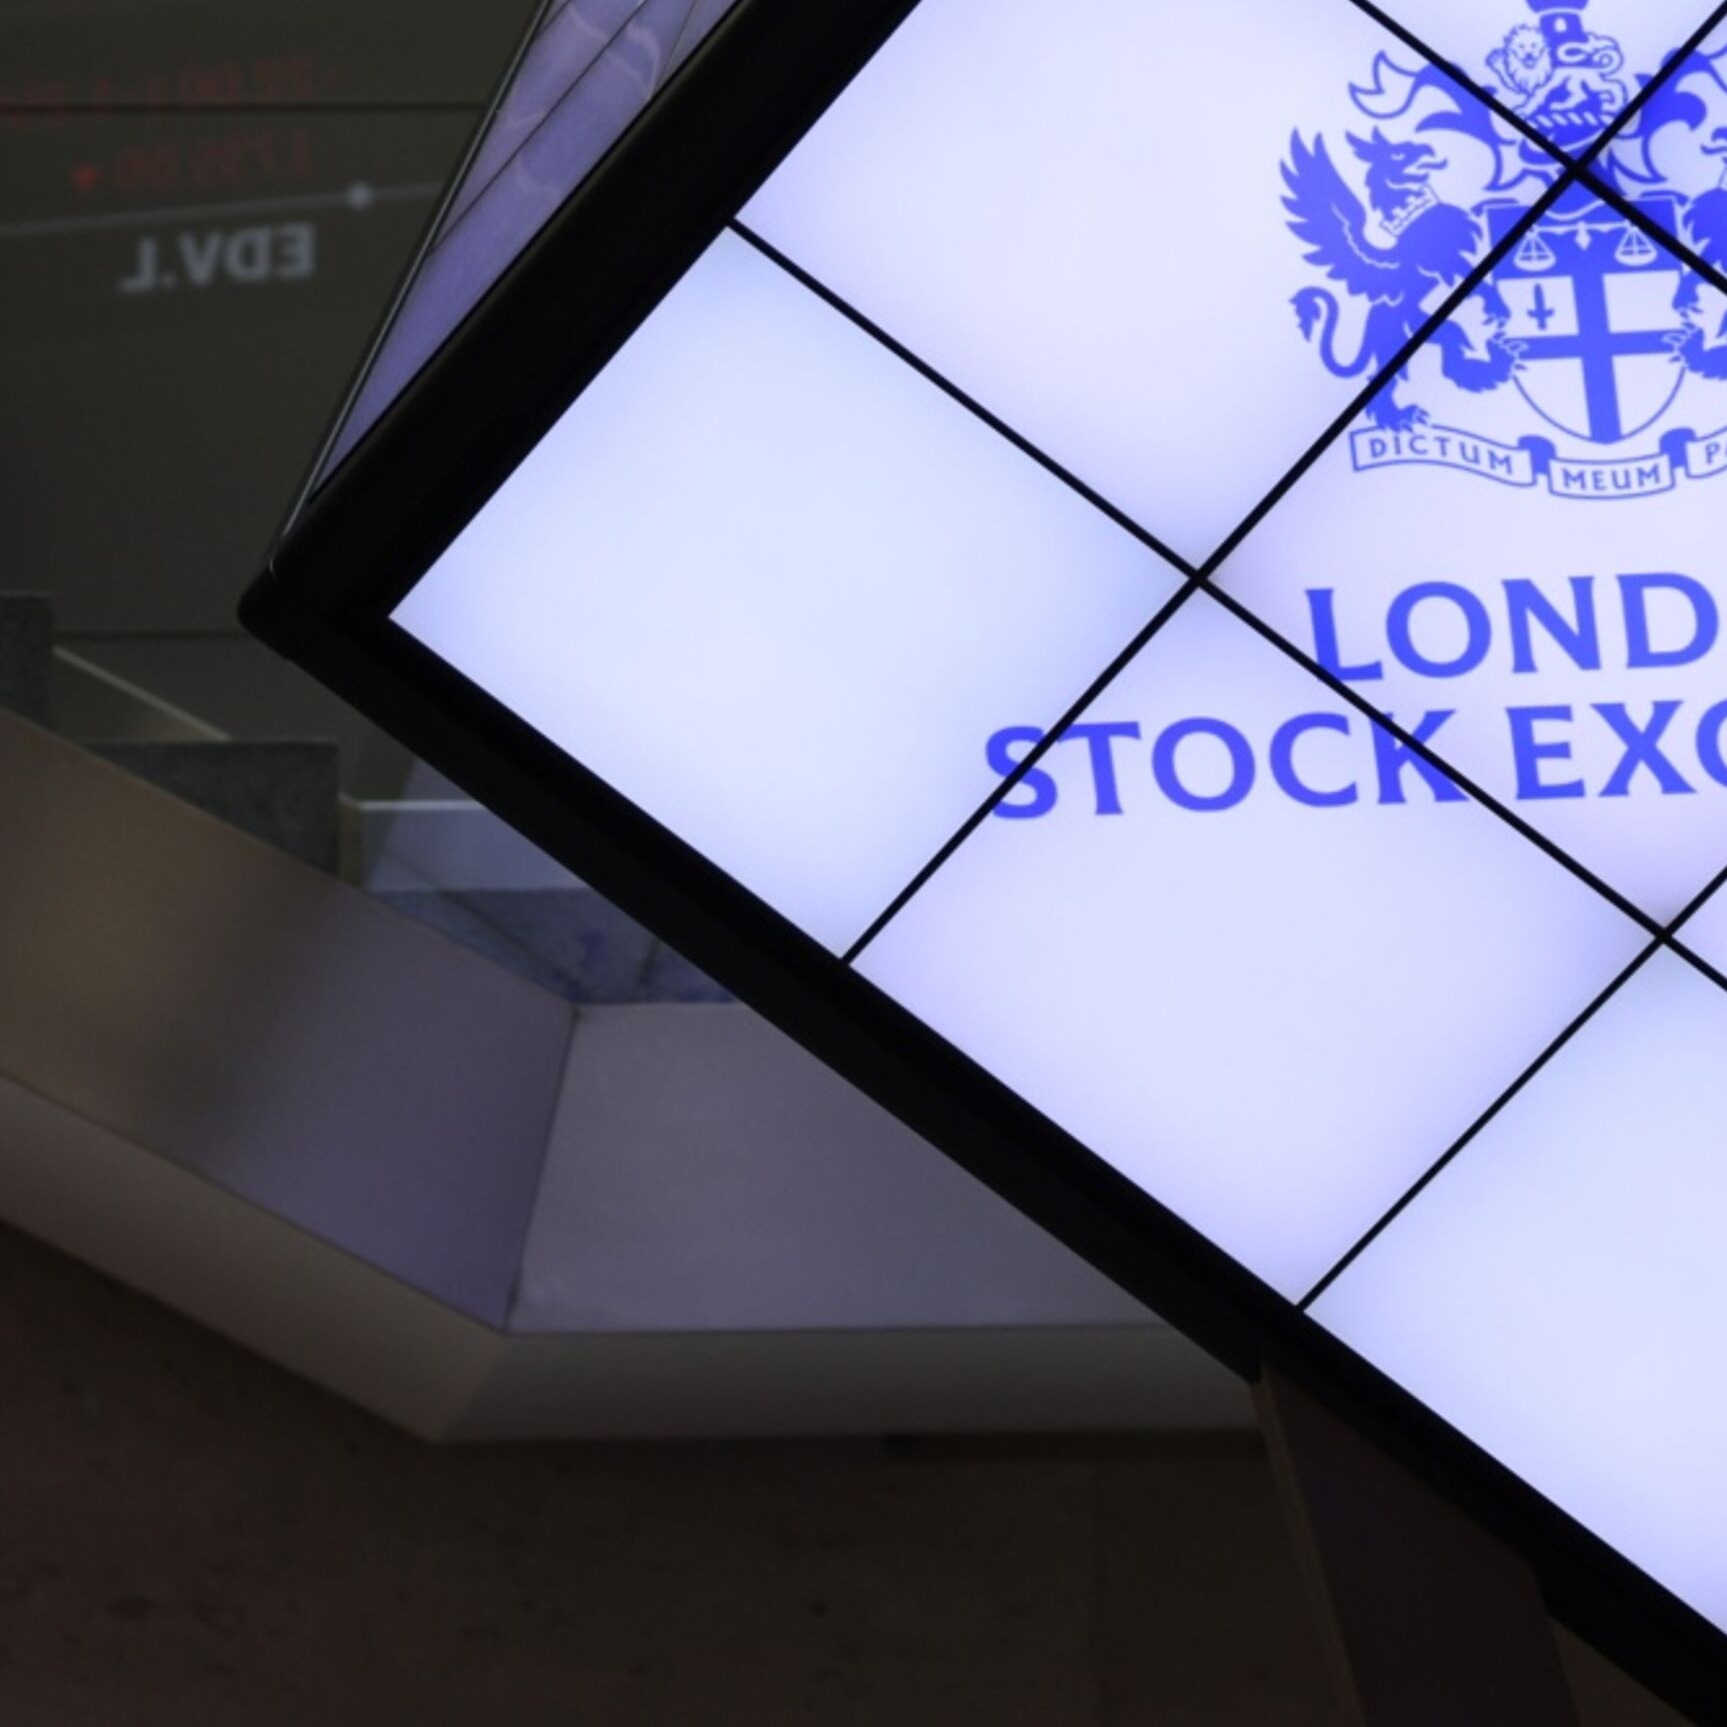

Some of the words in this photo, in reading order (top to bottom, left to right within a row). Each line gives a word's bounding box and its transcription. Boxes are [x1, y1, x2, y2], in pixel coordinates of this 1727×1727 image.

[1369, 435, 1513, 475] DICTUM
[1560, 462, 1662, 491] MEUM
[983, 710, 1470, 819] STOCK
